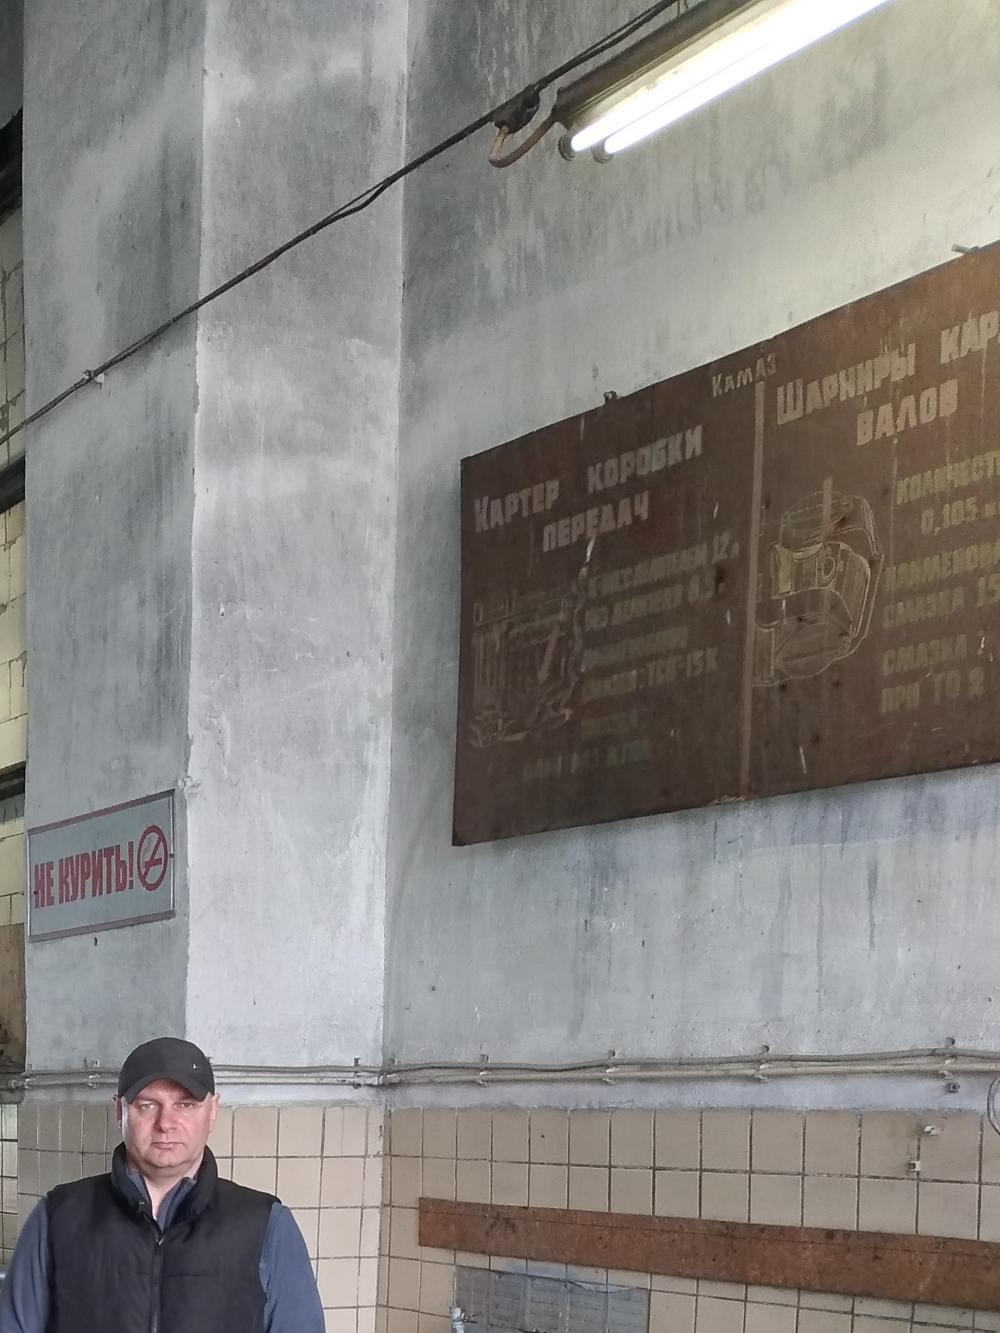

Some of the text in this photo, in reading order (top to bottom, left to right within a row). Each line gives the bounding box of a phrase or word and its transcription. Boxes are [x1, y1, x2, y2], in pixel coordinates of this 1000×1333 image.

[777, 311, 1000, 425] ШАРНИРЫ КАР
[856, 378, 958, 446] ВАЛОВ
[475, 424, 702, 533] КАРТЕР КОРОБКИ
[543, 491, 649, 552] ПЕРЕДАЧ
[34, 841, 134, 909] НЕ КУРИТЬ!
